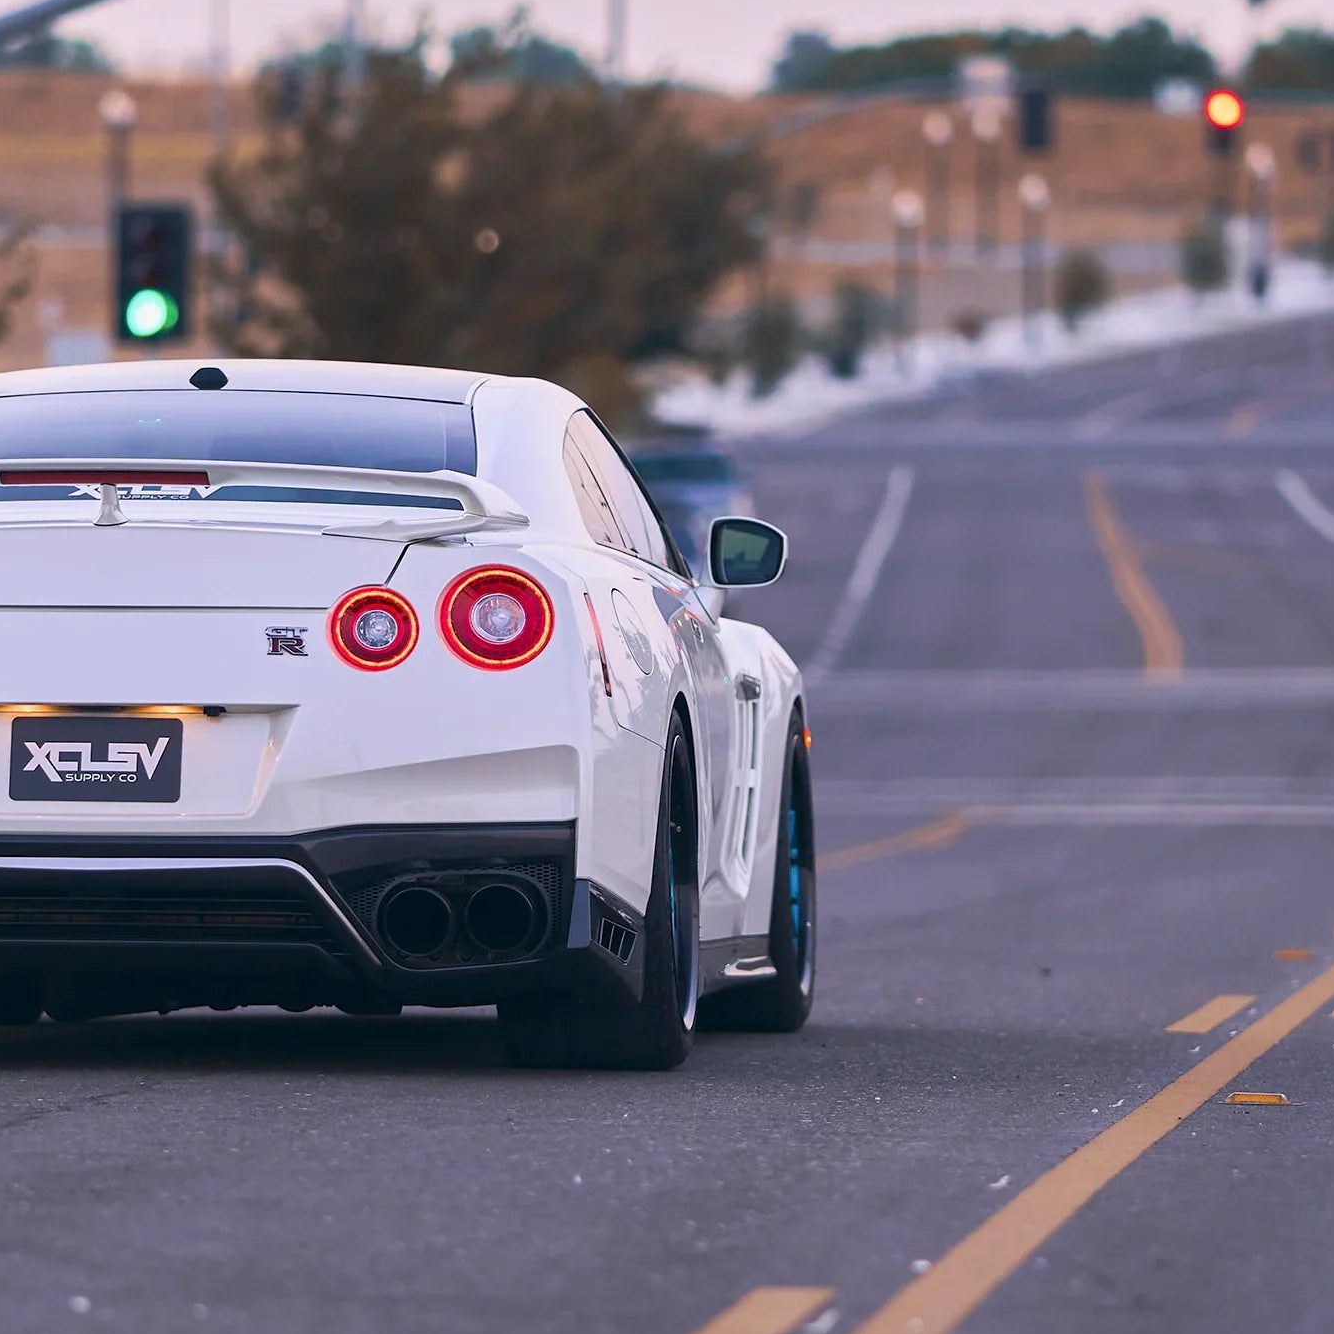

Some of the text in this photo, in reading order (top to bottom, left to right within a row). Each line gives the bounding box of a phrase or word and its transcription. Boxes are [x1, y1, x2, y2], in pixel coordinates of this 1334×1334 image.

[23, 737, 170, 782] XCLSV
[65, 773, 137, 782] SUPPLY CO
